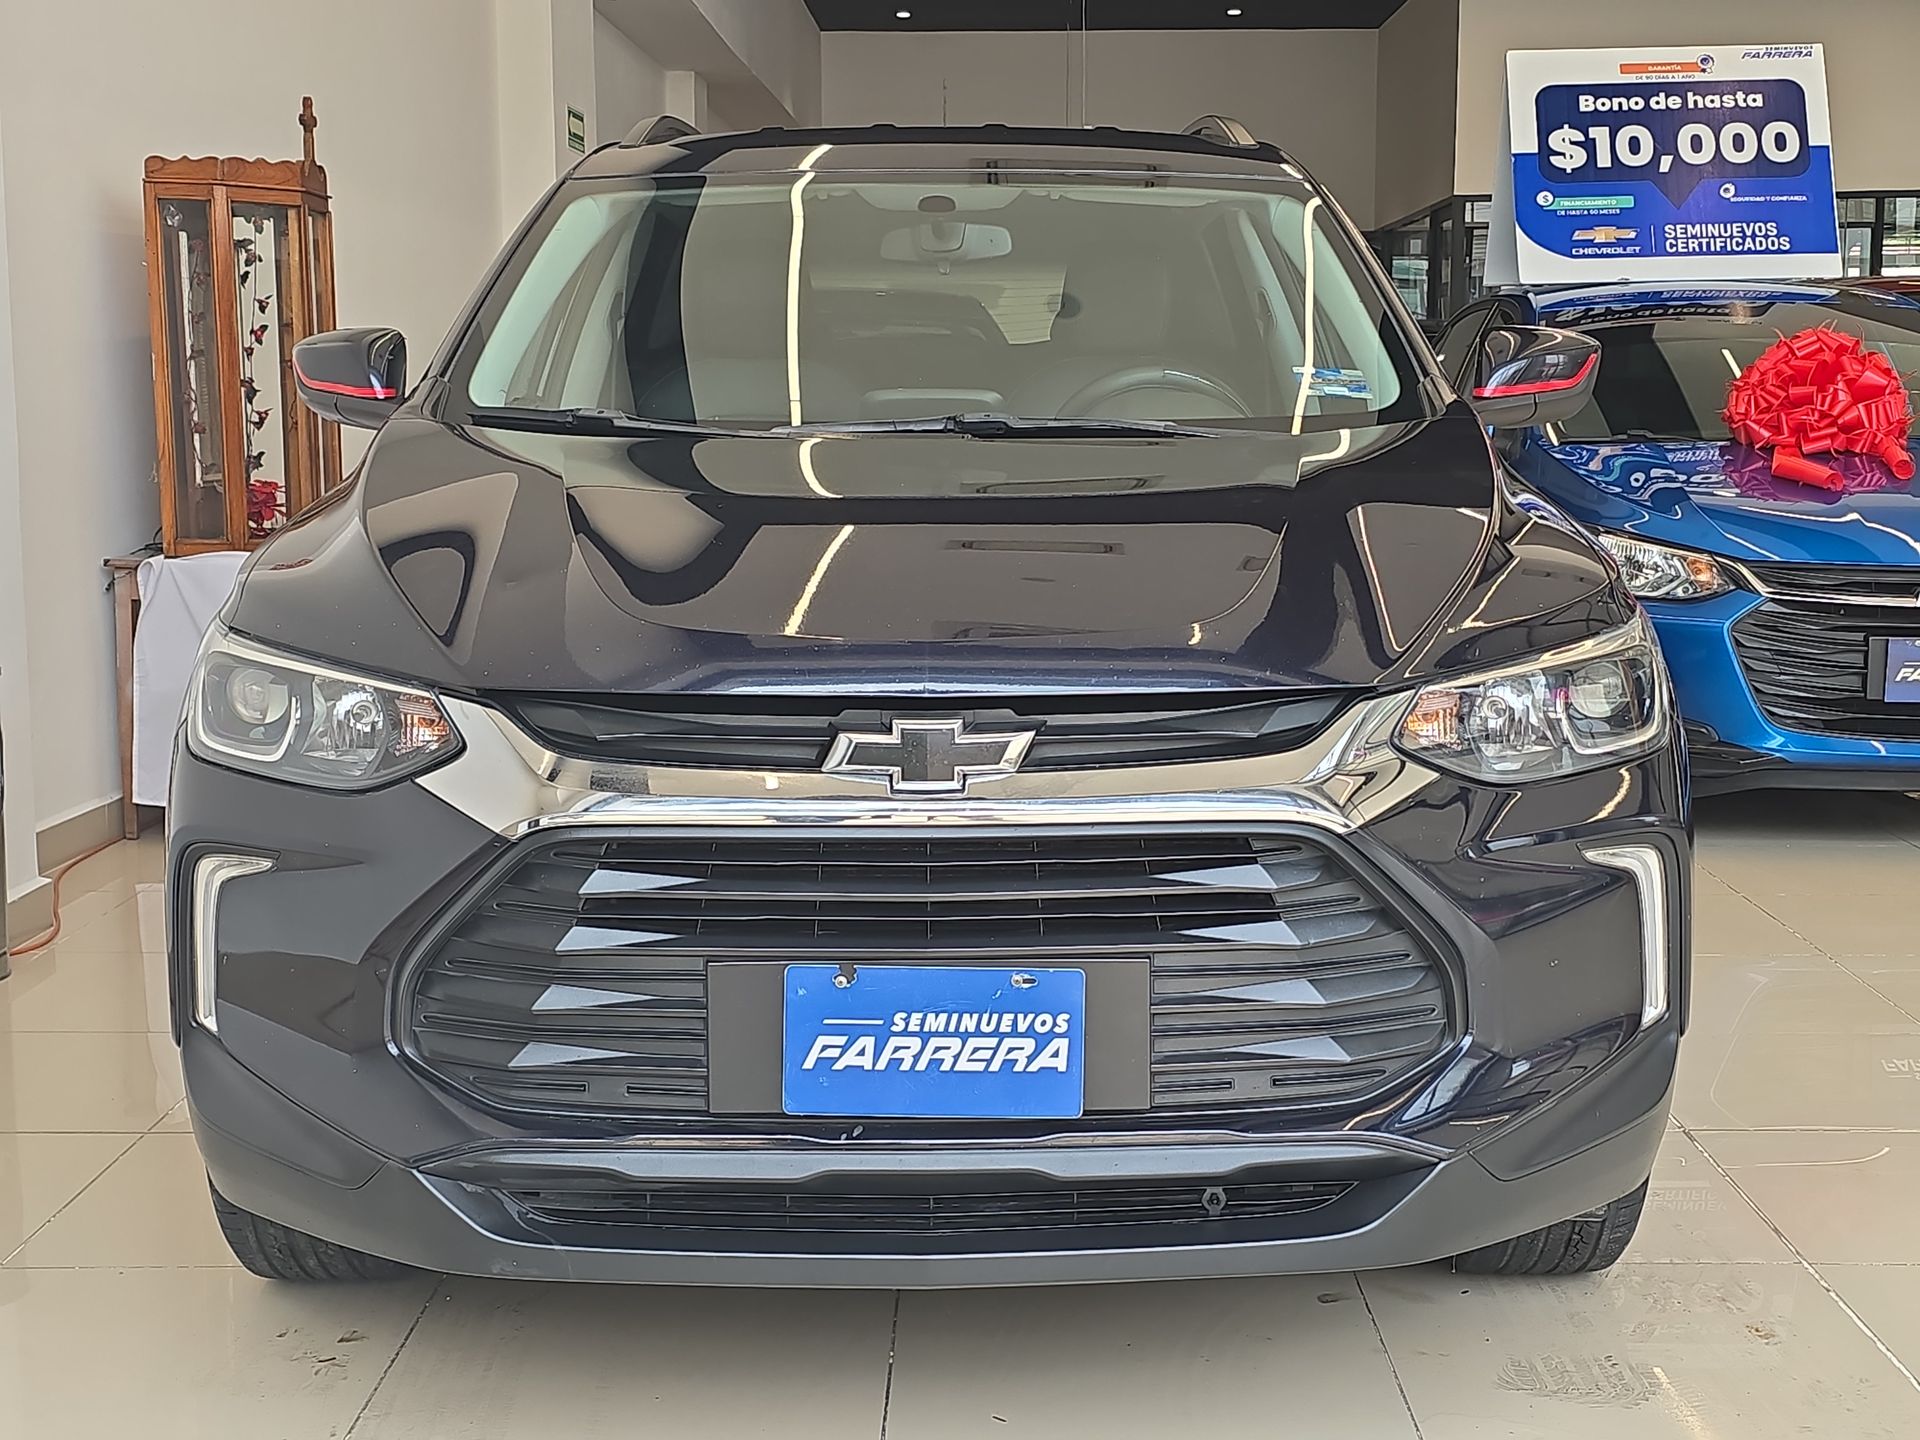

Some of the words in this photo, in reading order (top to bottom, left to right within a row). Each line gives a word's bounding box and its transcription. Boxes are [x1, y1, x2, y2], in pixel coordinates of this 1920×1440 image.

[1741, 50, 1813, 60] FARRERA
[1578, 93, 1645, 113] Bono
[1649, 92, 1683, 110] de
[1687, 91, 1764, 109] hasta
[1547, 121, 1801, 174] $10,000
[1664, 222, 1778, 238] SEMINUEVOS
[1572, 246, 1642, 255] CHEVROLET
[1665, 237, 1791, 253] CERTIFICADOS
[890, 1012, 1070, 1034] SEMINUEVOS
[801, 1035, 1070, 1072] FARRERA
